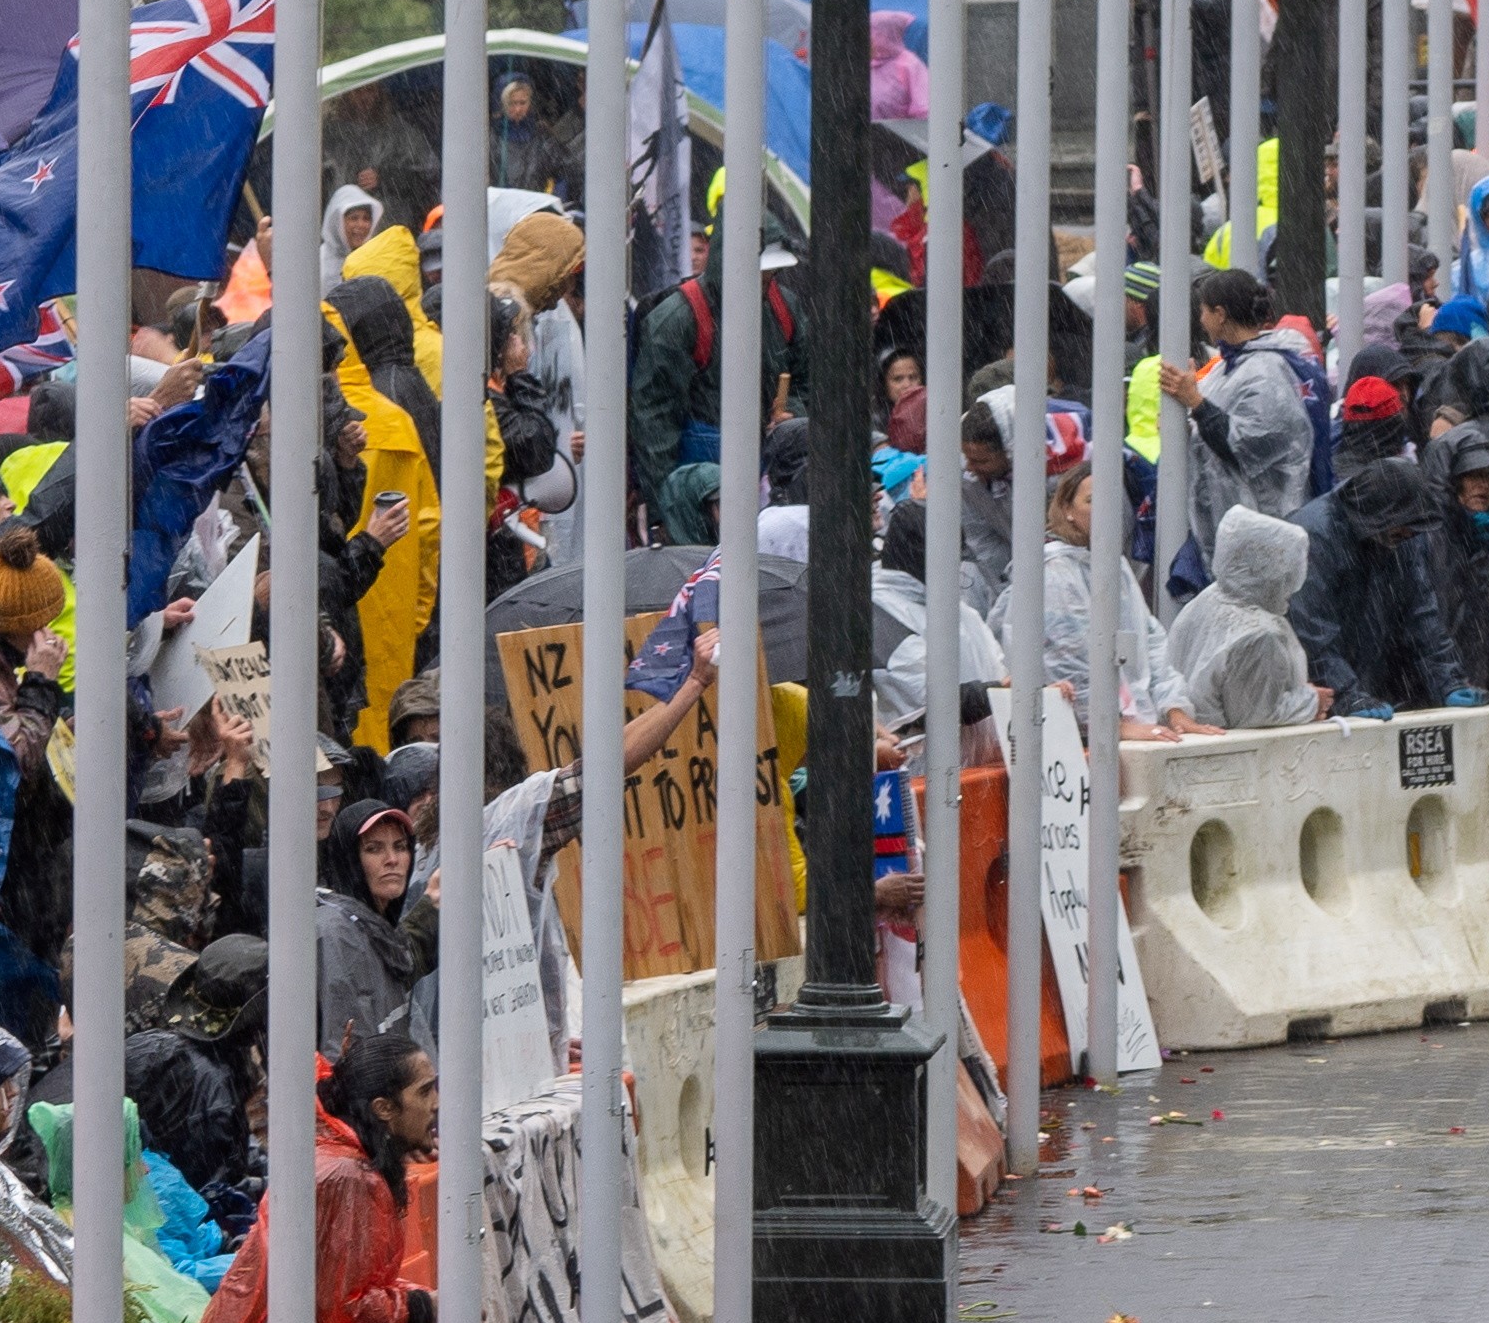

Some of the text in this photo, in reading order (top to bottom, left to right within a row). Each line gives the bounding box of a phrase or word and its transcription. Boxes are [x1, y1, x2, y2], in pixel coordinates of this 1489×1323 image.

[524, 642, 574, 698] NZ
[1406, 731, 1445, 754] RSEA
[653, 770, 688, 832] TO
